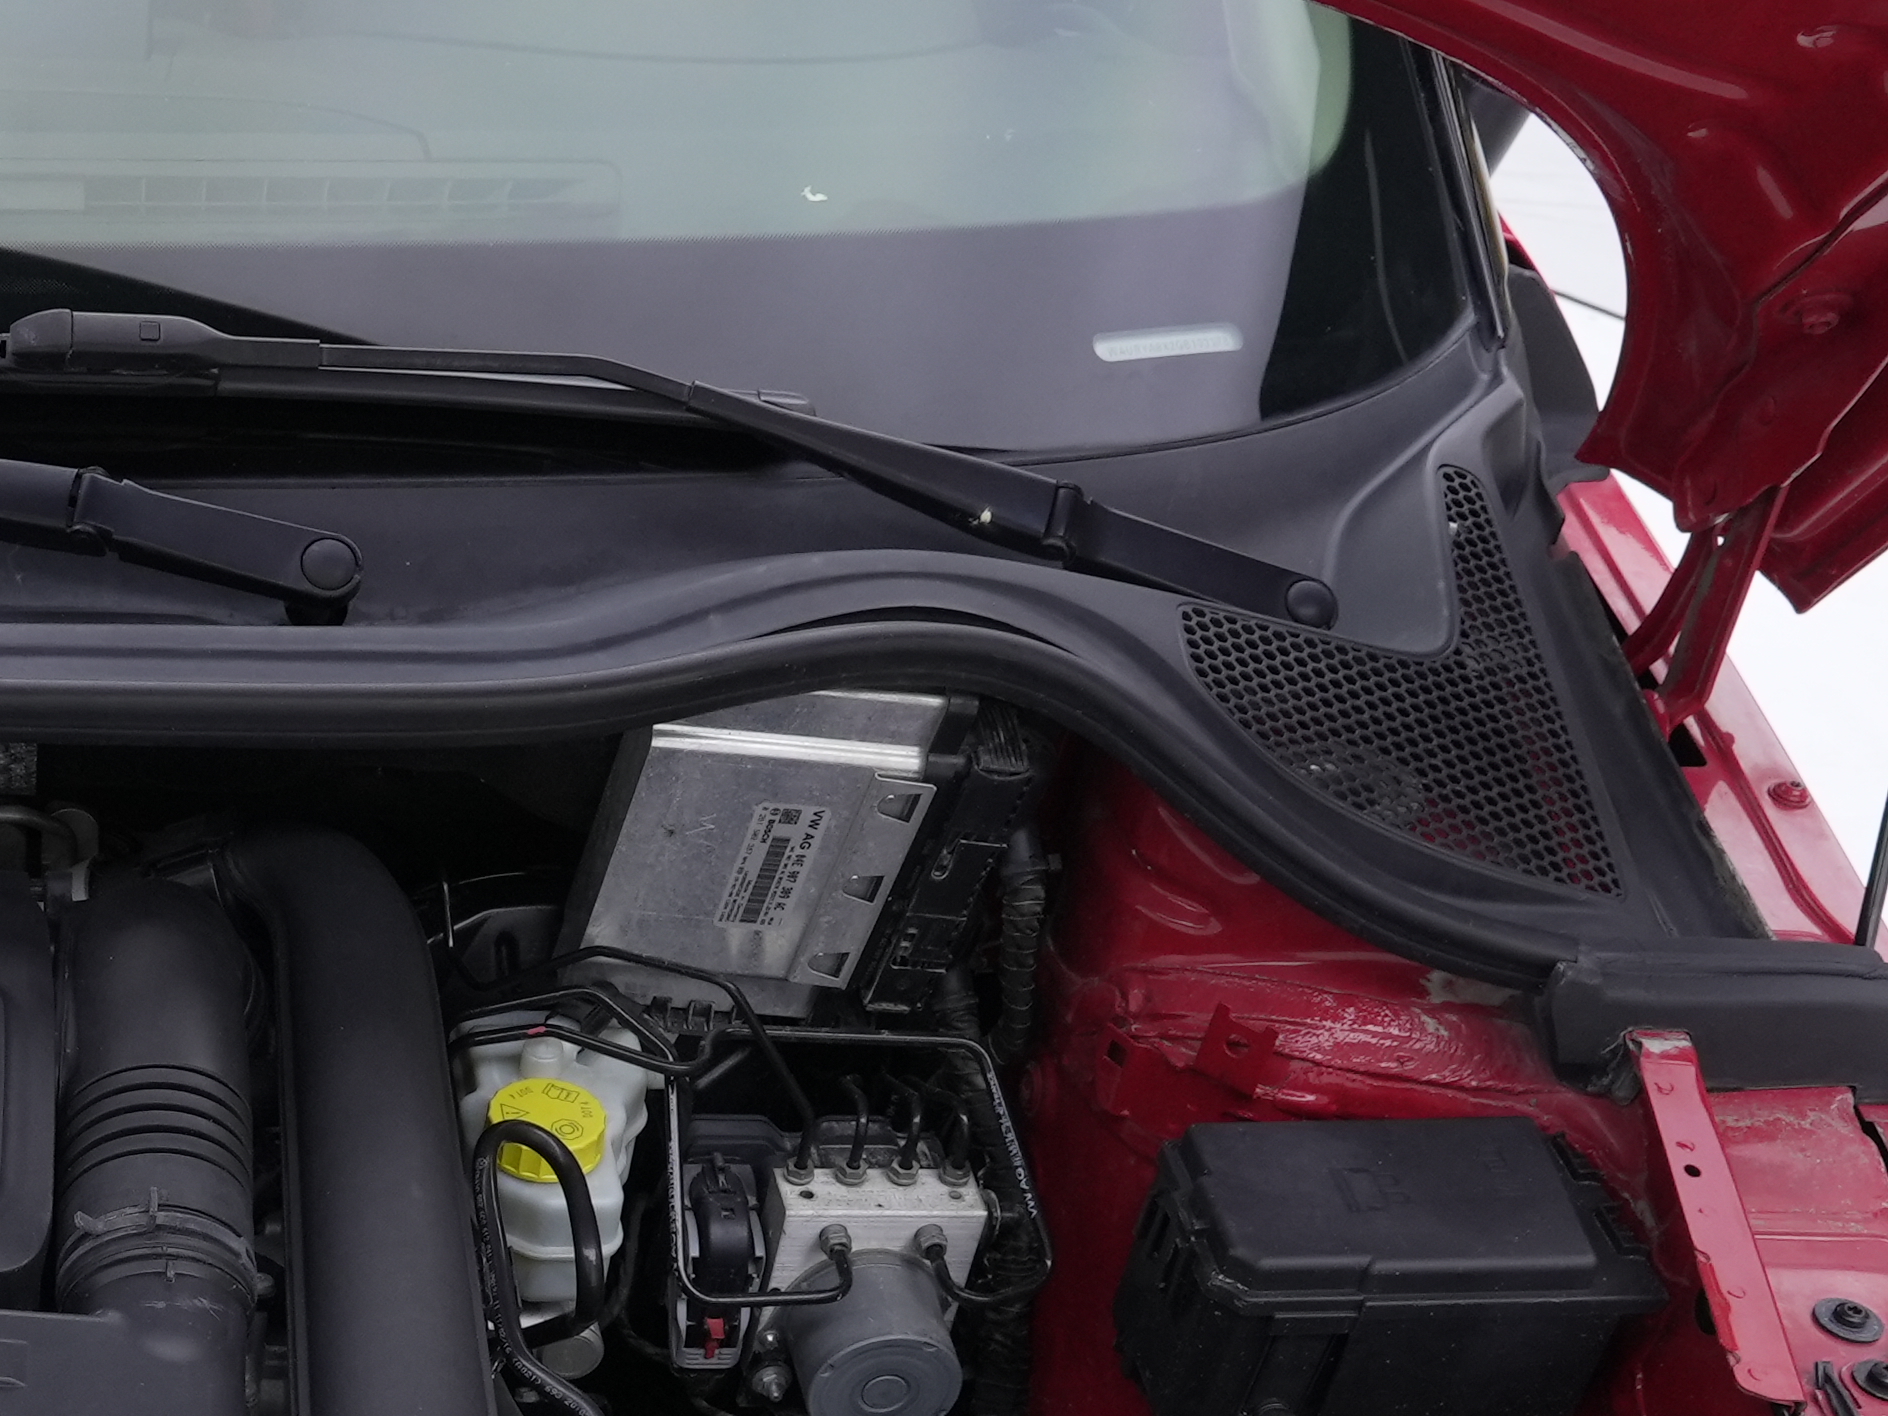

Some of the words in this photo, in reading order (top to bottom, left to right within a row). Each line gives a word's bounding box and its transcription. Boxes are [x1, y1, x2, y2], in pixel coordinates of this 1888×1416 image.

[759, 818, 776, 843] BOSCH
[806, 809, 825, 830] VW
[797, 832, 816, 850] AG
[1015, 1168, 1030, 1190] AG
[1022, 1192, 1038, 1219] VW
